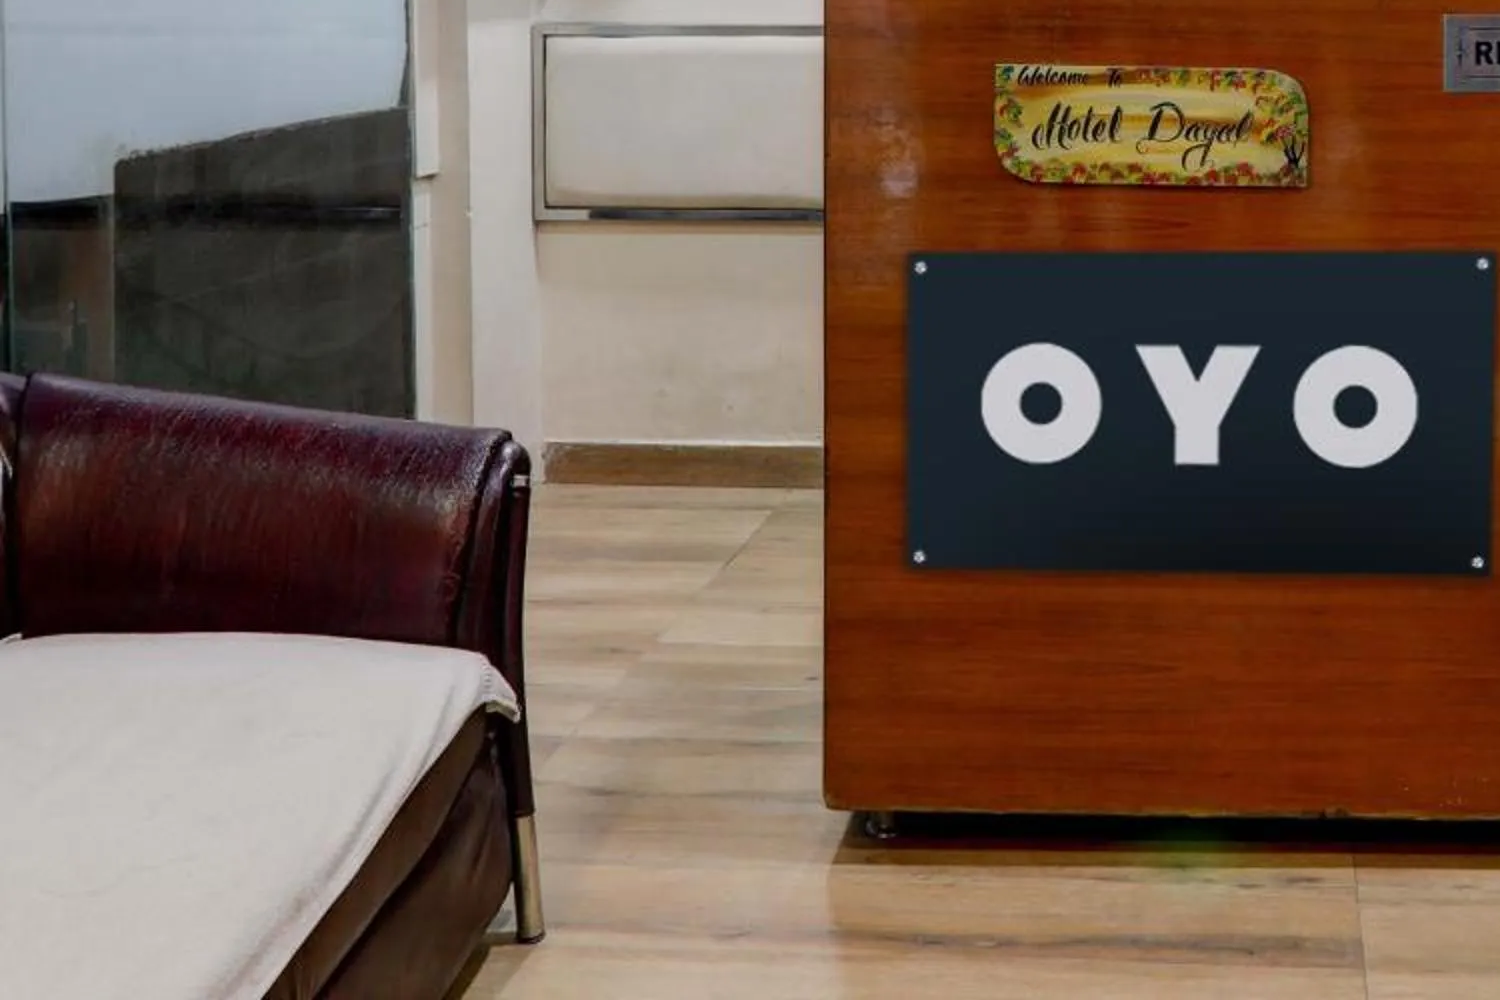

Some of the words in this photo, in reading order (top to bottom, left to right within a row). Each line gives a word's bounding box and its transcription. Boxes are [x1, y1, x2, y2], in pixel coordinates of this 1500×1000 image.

[1016, 64, 1091, 87] Welcome
[1105, 66, 1125, 88] To
[1031, 99, 1124, 151] Hotel
[1136, 101, 1254, 170] Dayal
[981, 342, 1418, 468] OYO
